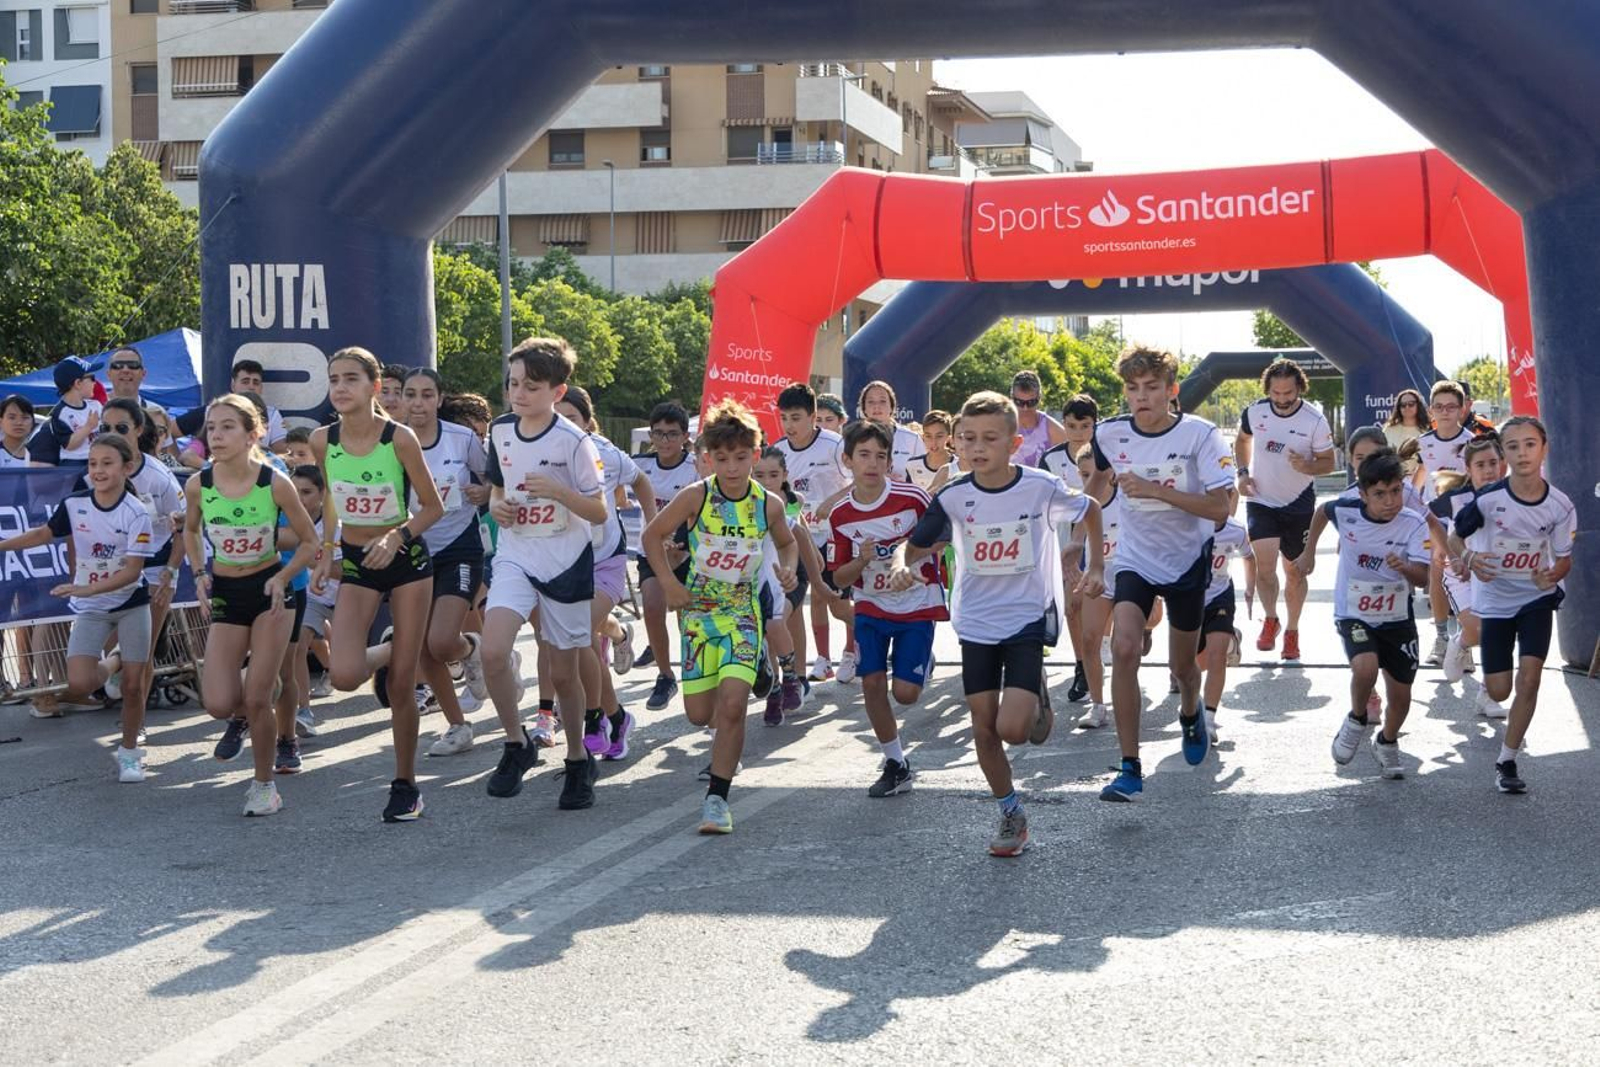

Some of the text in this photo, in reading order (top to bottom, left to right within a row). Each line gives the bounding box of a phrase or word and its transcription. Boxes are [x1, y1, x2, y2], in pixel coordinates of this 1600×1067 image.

[977, 189, 1315, 240] Sports Santander
[1083, 236, 1196, 254] sportssantander.es
[229, 263, 330, 329] RUTA
[727, 342, 773, 362] Sports
[720, 367, 793, 388] Santander
[345, 497, 387, 514] 837
[516, 504, 555, 525] 852
[223, 537, 263, 554] 834
[974, 538, 1020, 562] 804
[706, 550, 751, 571] 854
[1358, 594, 1396, 611] 841
